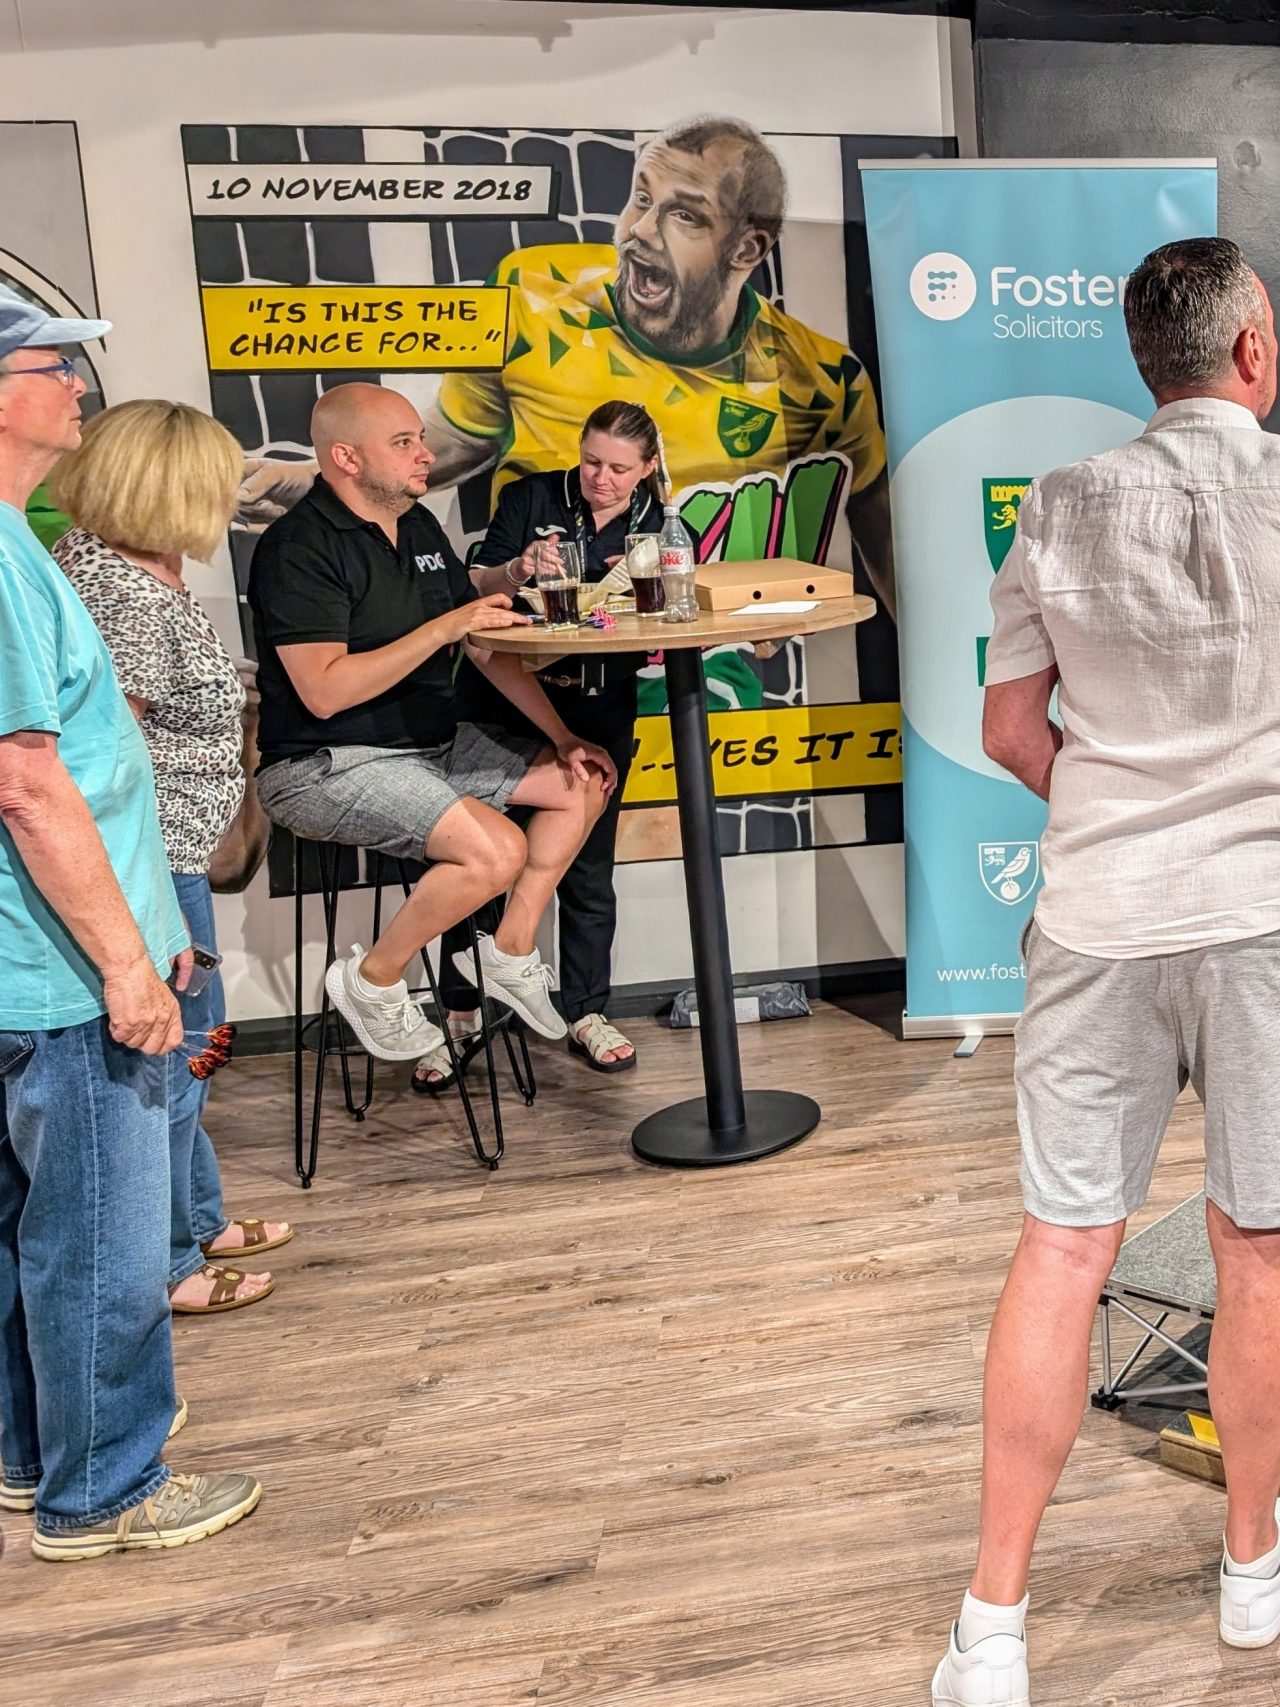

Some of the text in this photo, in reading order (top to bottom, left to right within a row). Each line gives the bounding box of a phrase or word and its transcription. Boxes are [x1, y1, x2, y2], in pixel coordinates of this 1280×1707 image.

[207, 177, 532, 201] 10 NOVEMBER 2018
[248, 298, 478, 324] "IS THIS THE
[993, 313, 1104, 339] Solicitors
[229, 331, 364, 357] CHANCE
[794, 731, 855, 764] IT
[867, 728, 903, 759] I
[936, 963, 1027, 981] www.fost
